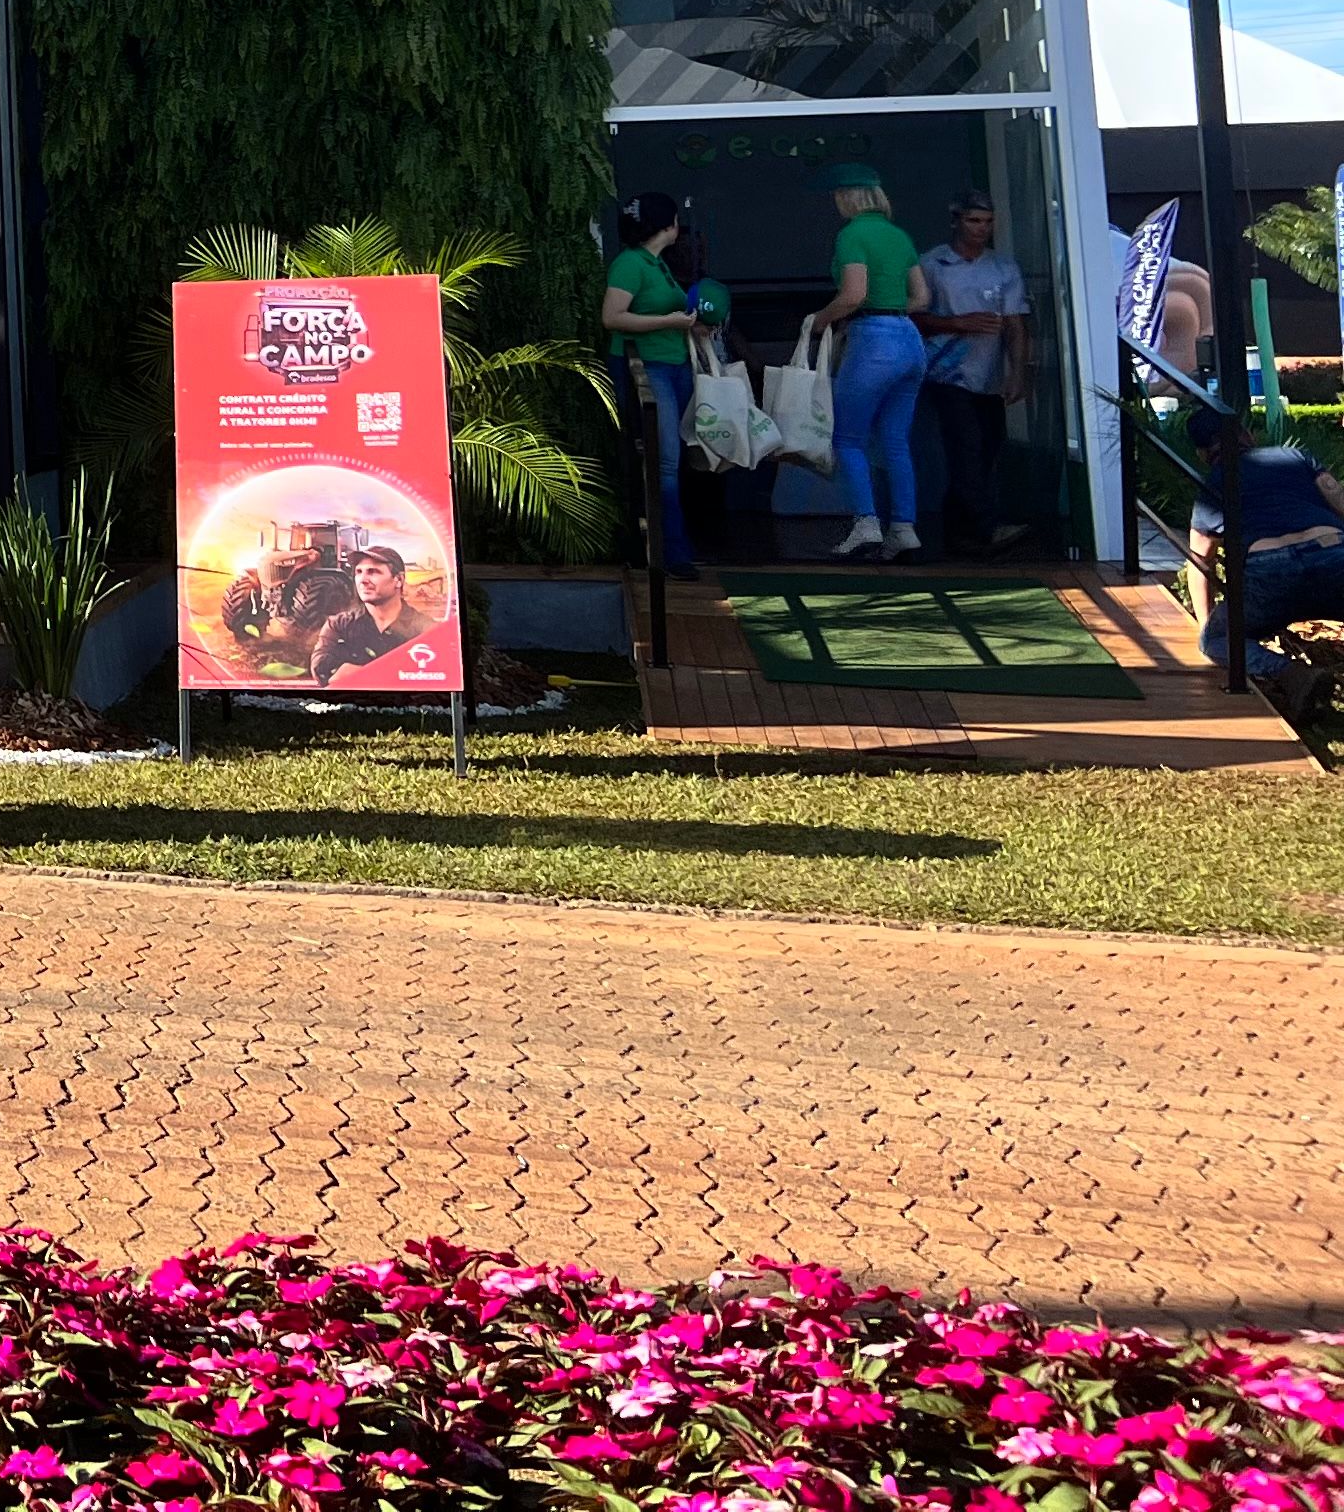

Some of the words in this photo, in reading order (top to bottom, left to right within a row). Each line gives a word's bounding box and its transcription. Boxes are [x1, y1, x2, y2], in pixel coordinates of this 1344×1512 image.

[263, 309, 368, 338] FORÇA
[304, 331, 333, 345] NO
[259, 344, 372, 368] CAMPO
[219, 395, 277, 405] CONTRATE
[279, 393, 327, 403] CRÉDITO
[219, 406, 256, 415] RURAL
[258, 406, 265, 415] E
[267, 405, 328, 415] CONCORRA
[219, 418, 228, 427] A
[230, 418, 287, 426] TRATORES
[398, 669, 446, 681] bradesco
